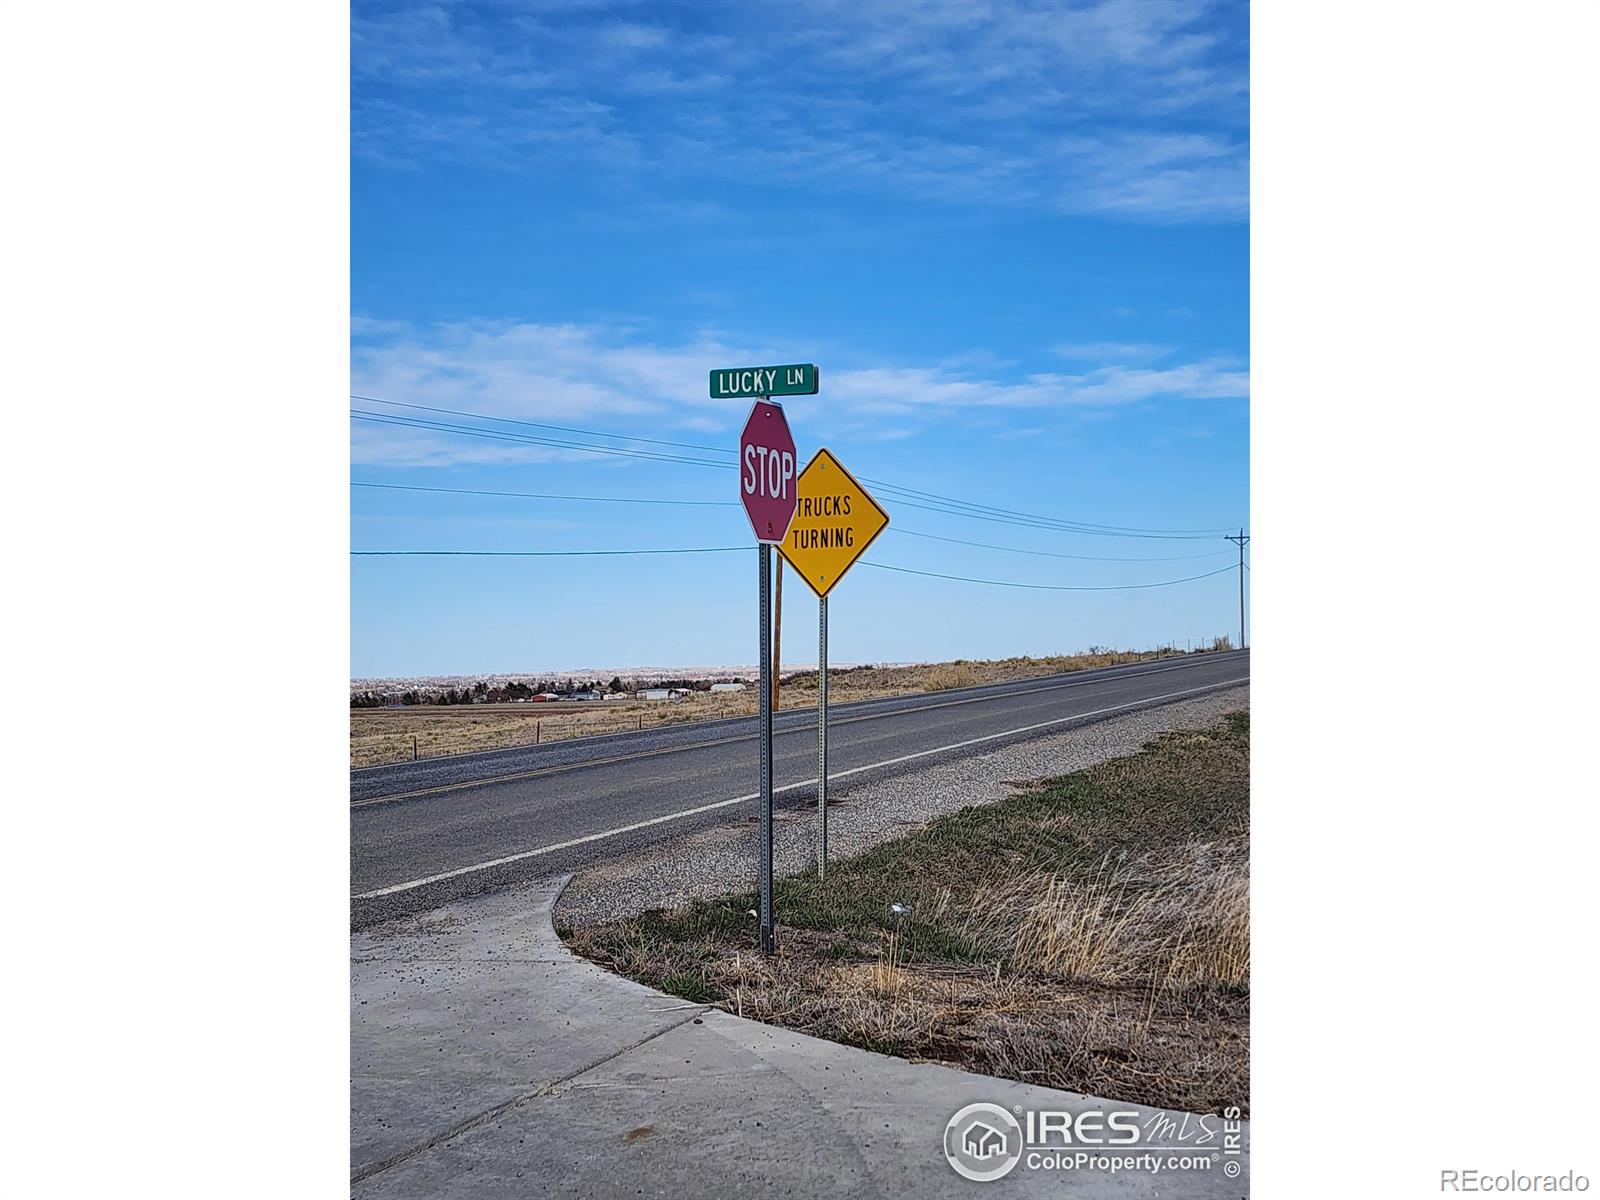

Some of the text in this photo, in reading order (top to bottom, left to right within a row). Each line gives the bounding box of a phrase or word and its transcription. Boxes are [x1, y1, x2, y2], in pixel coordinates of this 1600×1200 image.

[719, 368, 804, 394] LUCKY LN
[743, 443, 794, 500] STOP
[797, 495, 851, 517] TRUCKS
[792, 527, 854, 549] TURNING
